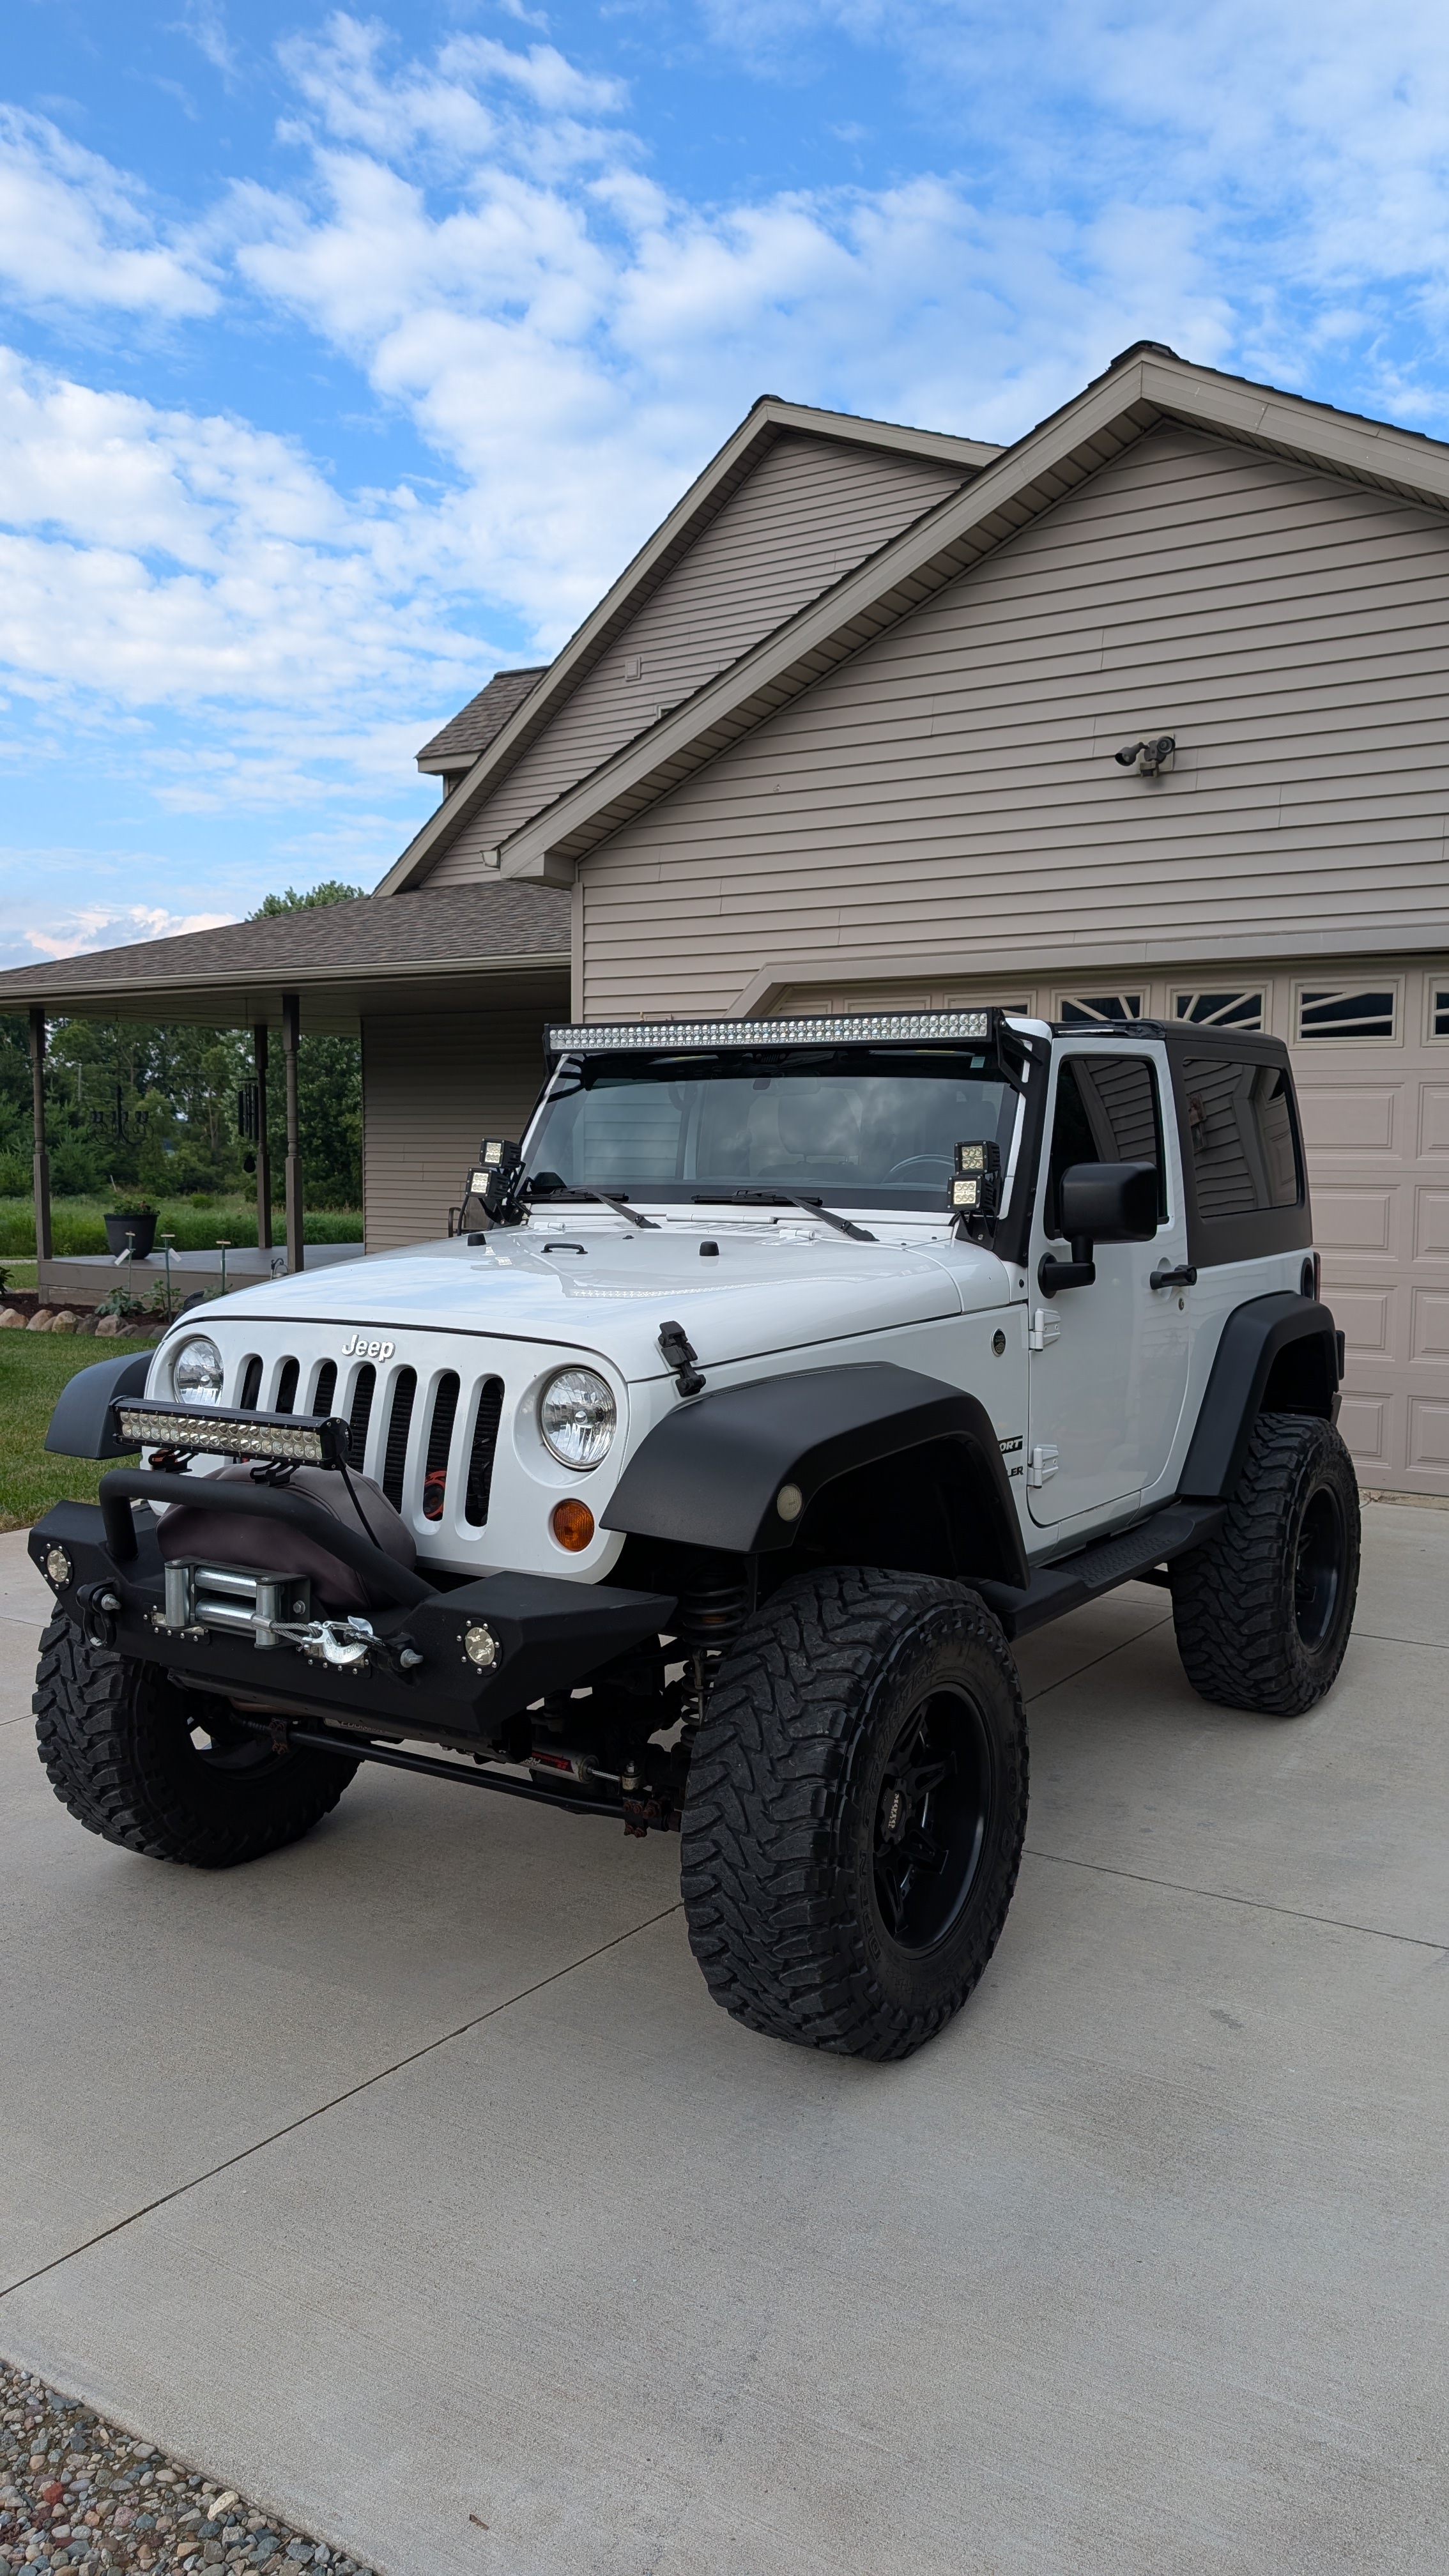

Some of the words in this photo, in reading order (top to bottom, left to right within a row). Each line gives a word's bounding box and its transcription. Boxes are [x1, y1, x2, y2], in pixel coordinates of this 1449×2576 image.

[342, 1334, 395, 1363] Jeep
[999, 1439, 1022, 1452] ORT
[864, 1652, 940, 1829] COUNTRY
[891, 1793, 900, 1829] MOTO
[1001, 1731, 1018, 1862] TOYO
[860, 1850, 882, 1961] OPEN
